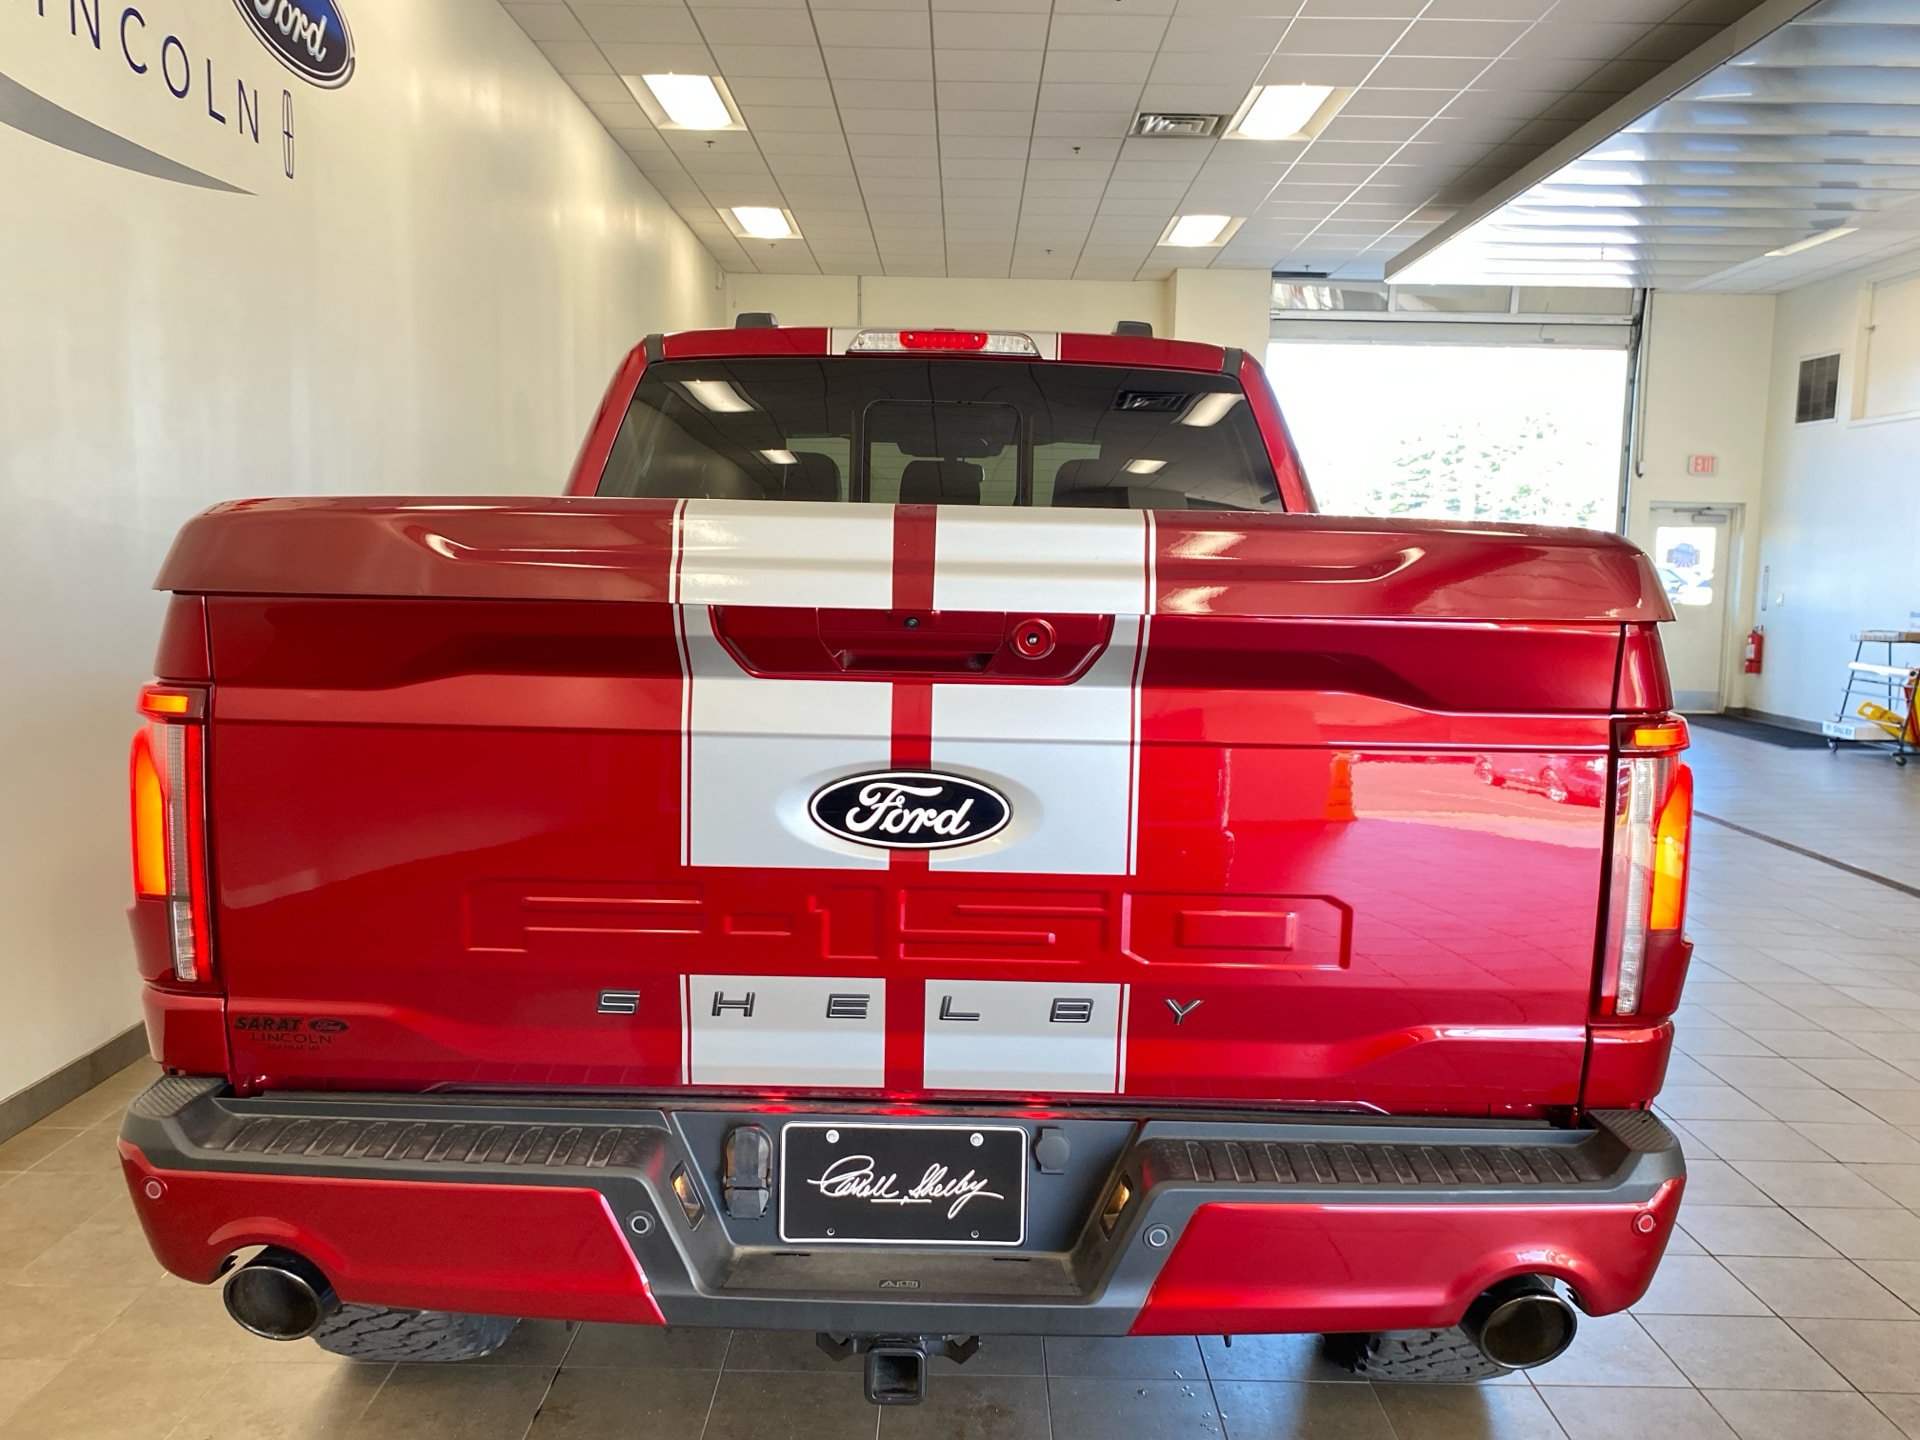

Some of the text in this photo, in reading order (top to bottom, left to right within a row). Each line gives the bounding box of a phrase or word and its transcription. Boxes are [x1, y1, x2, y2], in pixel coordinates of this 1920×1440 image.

[37, 0, 260, 145] NCOLN
[1694, 456, 1716, 473] EXIT
[845, 782, 975, 836] Ford
[463, 877, 1354, 972] F-150
[235, 1017, 304, 1031] SARAT
[597, 989, 1204, 1026] SHELBY
[250, 1032, 332, 1044] LINCOLN
[807, 1154, 1005, 1220] Carroll Shelby
